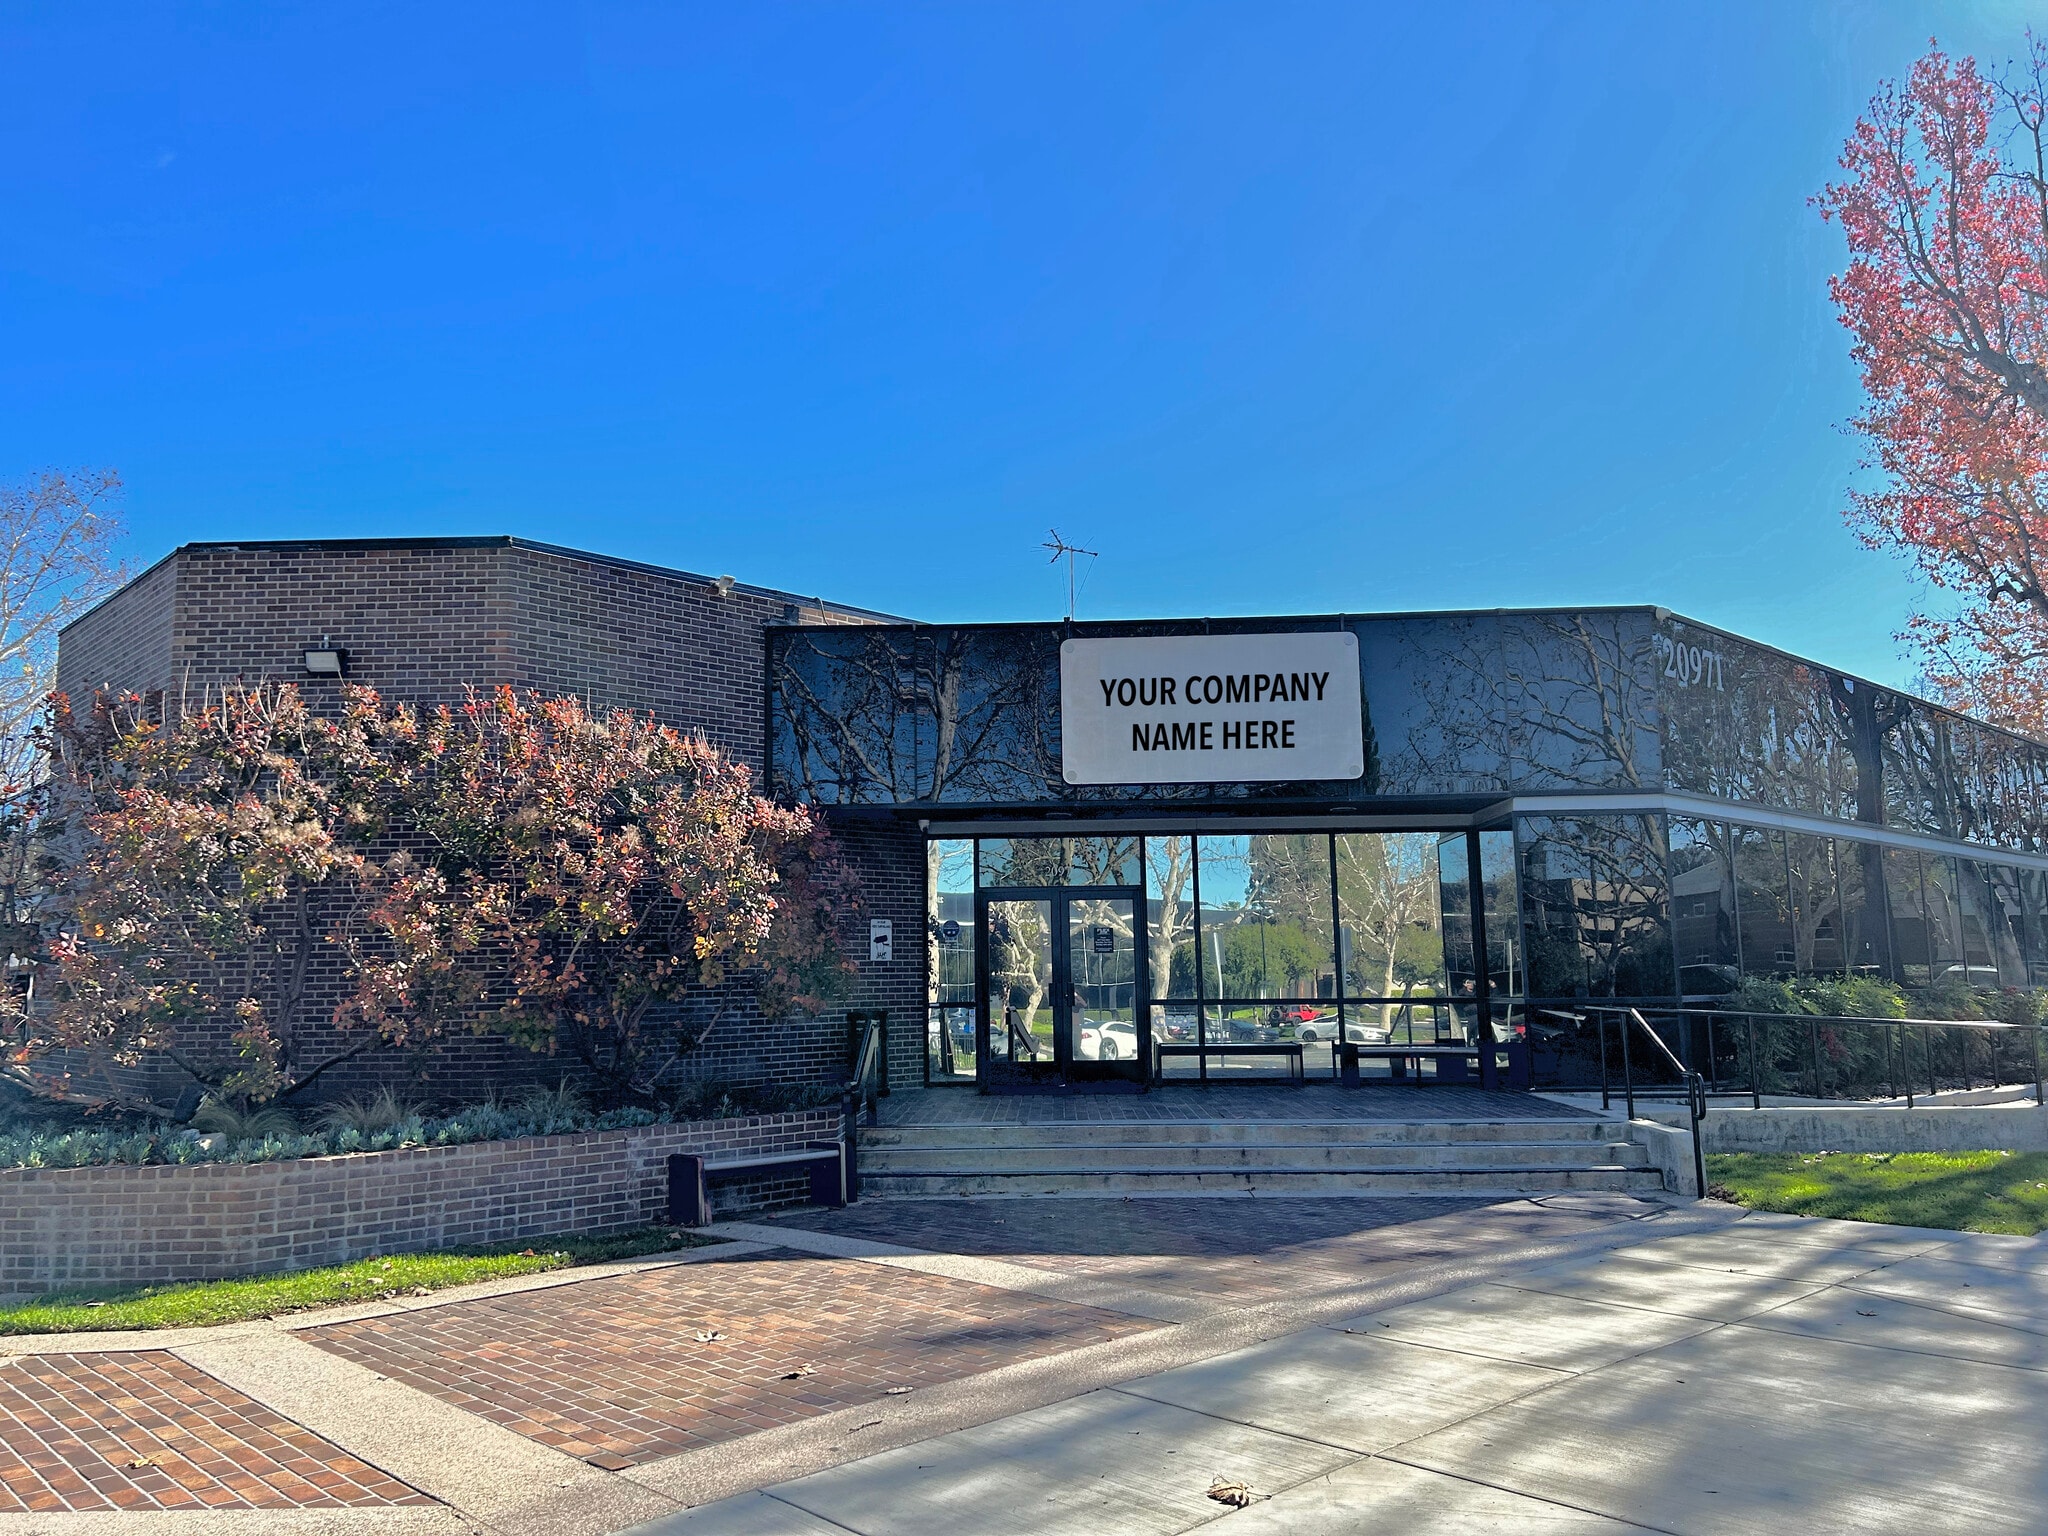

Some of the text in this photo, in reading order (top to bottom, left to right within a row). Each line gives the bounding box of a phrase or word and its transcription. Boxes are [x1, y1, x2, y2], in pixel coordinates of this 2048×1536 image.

[1662, 637, 1725, 692] 20971
[1099, 671, 1330, 707] YOUR COMPANY
[1131, 719, 1296, 752] NAME HERE
